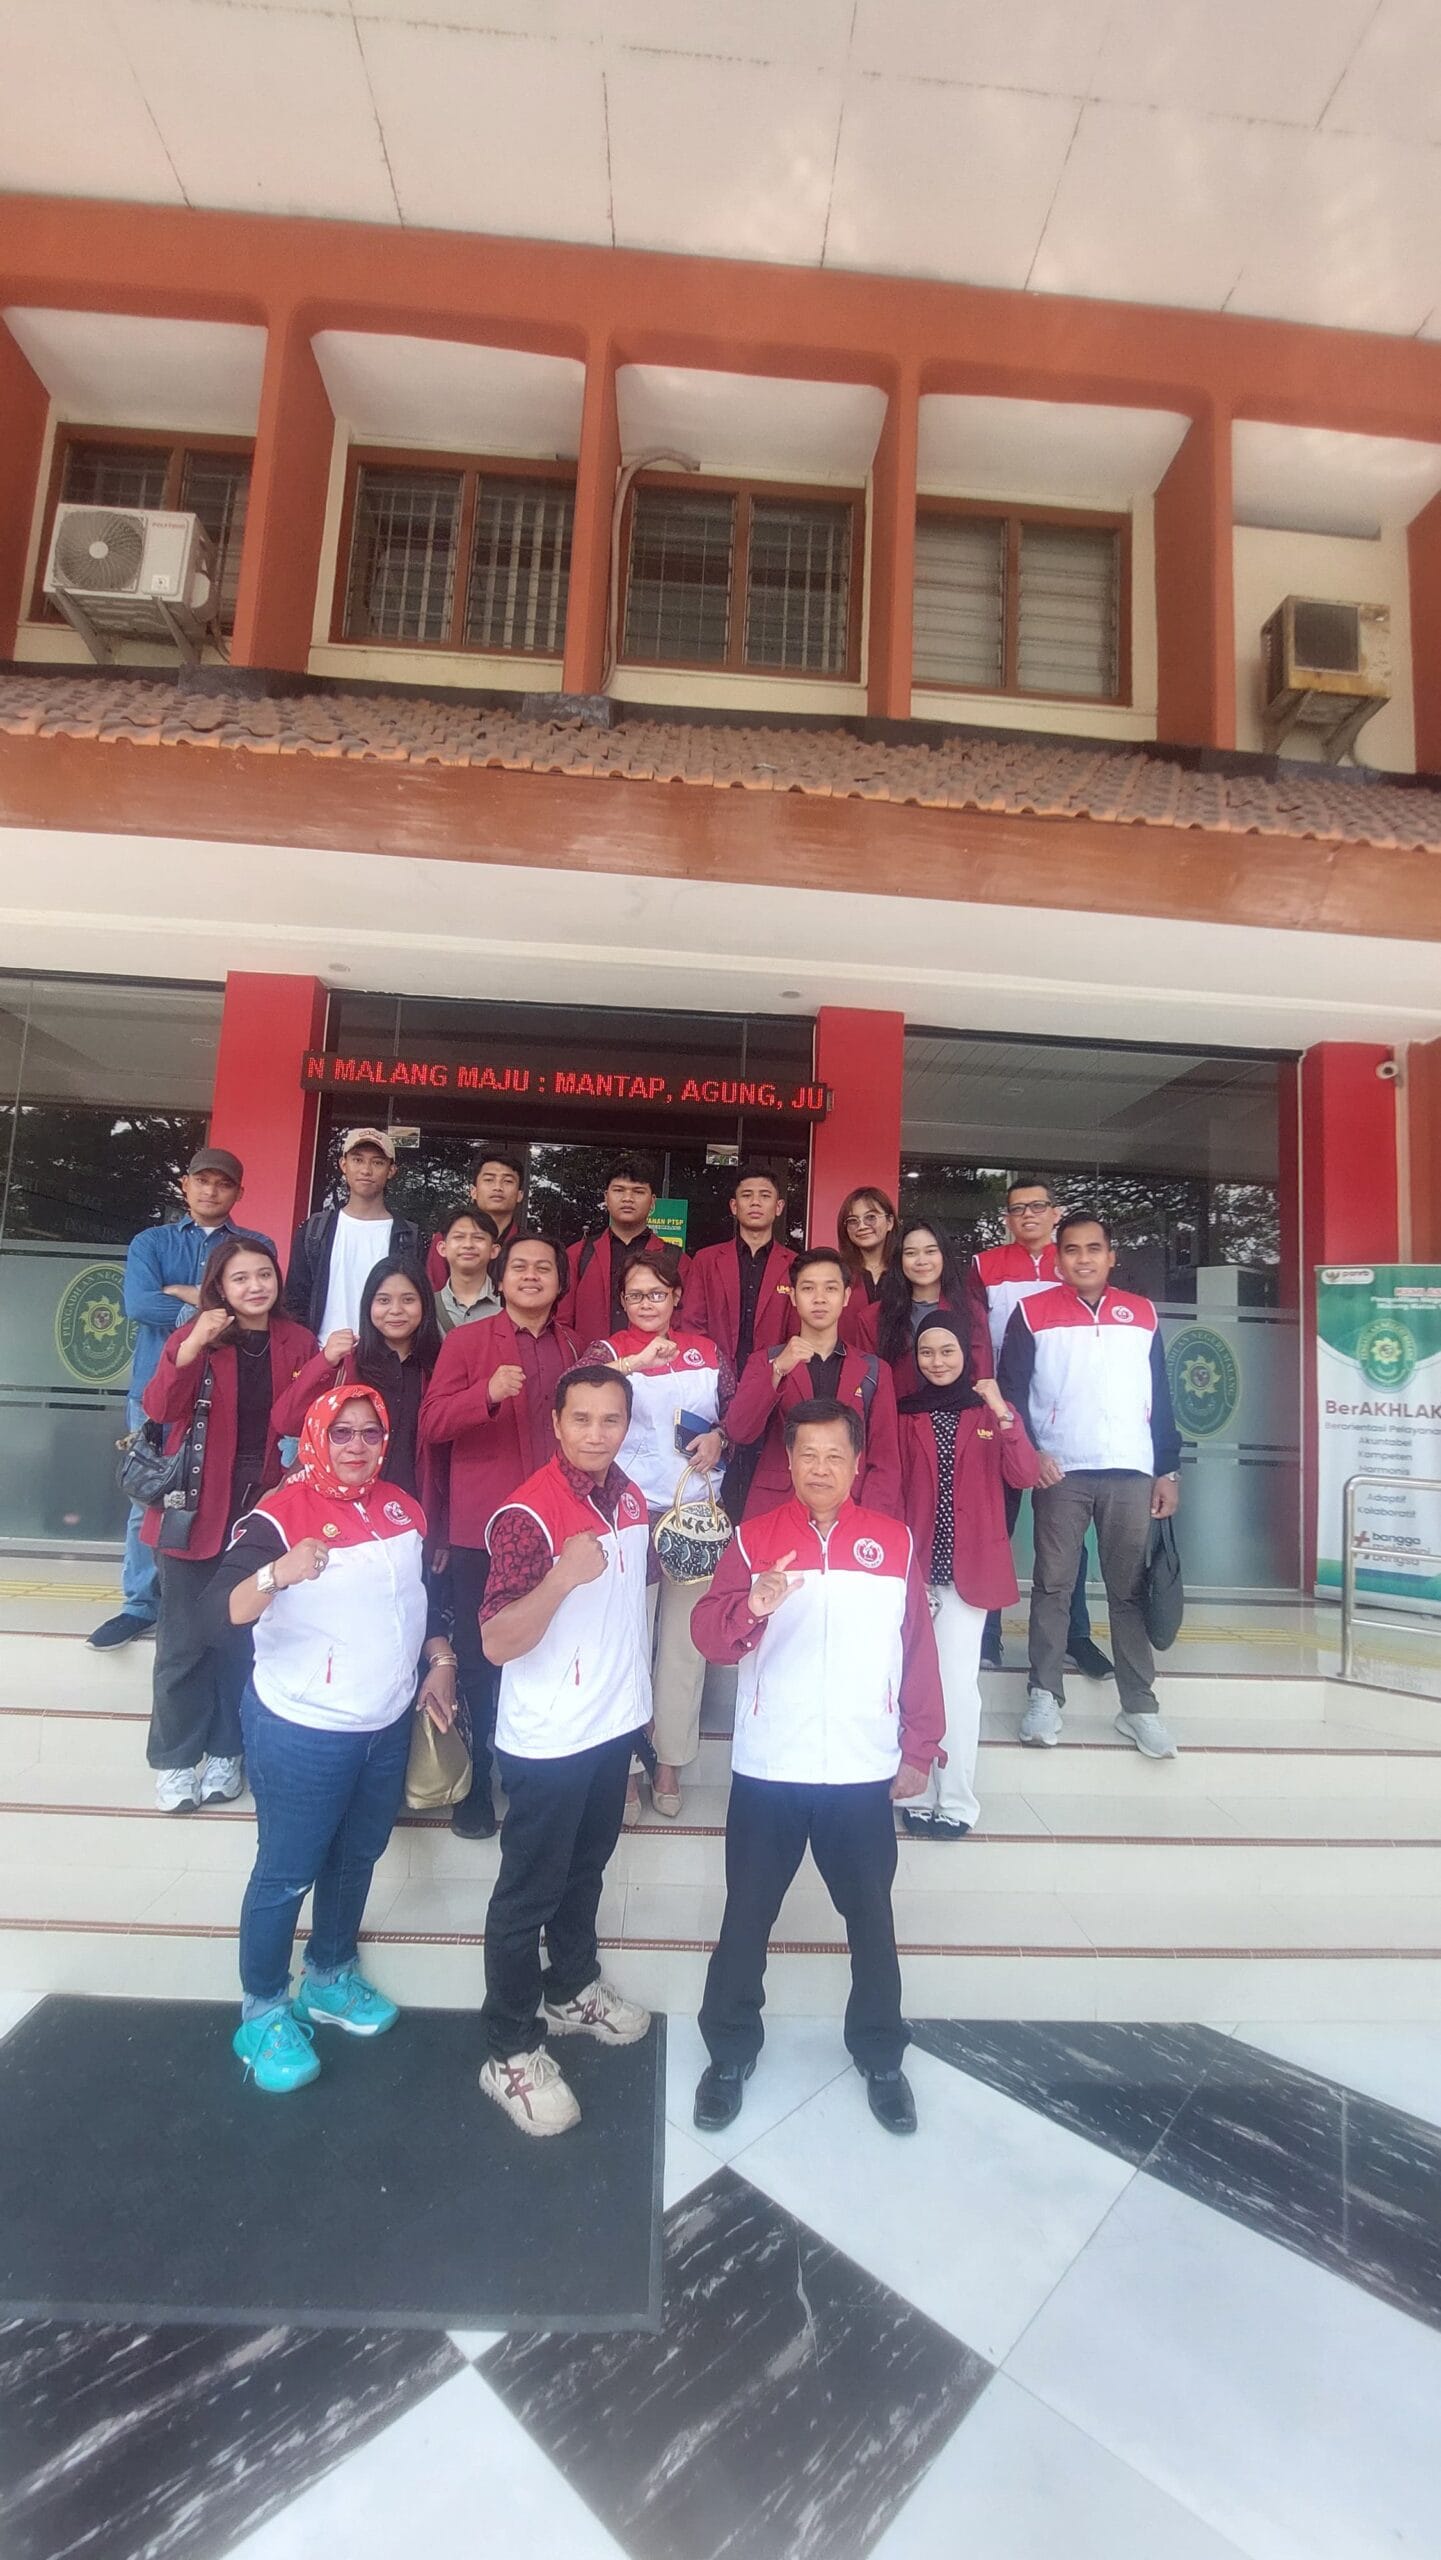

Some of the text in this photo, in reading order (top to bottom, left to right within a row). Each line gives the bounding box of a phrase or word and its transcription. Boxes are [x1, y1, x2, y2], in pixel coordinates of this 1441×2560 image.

[307, 1057, 325, 1080] N
[334, 1058, 449, 1087] MALANG
[457, 1065, 530, 1093] MAJU
[554, 1071, 673, 1104] MANTAP,
[681, 1079, 784, 1110] AGUNG,
[791, 1086, 824, 1110] JU
[1325, 1400, 1441, 1419] BerAKHLAK
[1388, 1424, 1441, 1436] Pelayana
[1372, 1531, 1422, 1547] bangga
